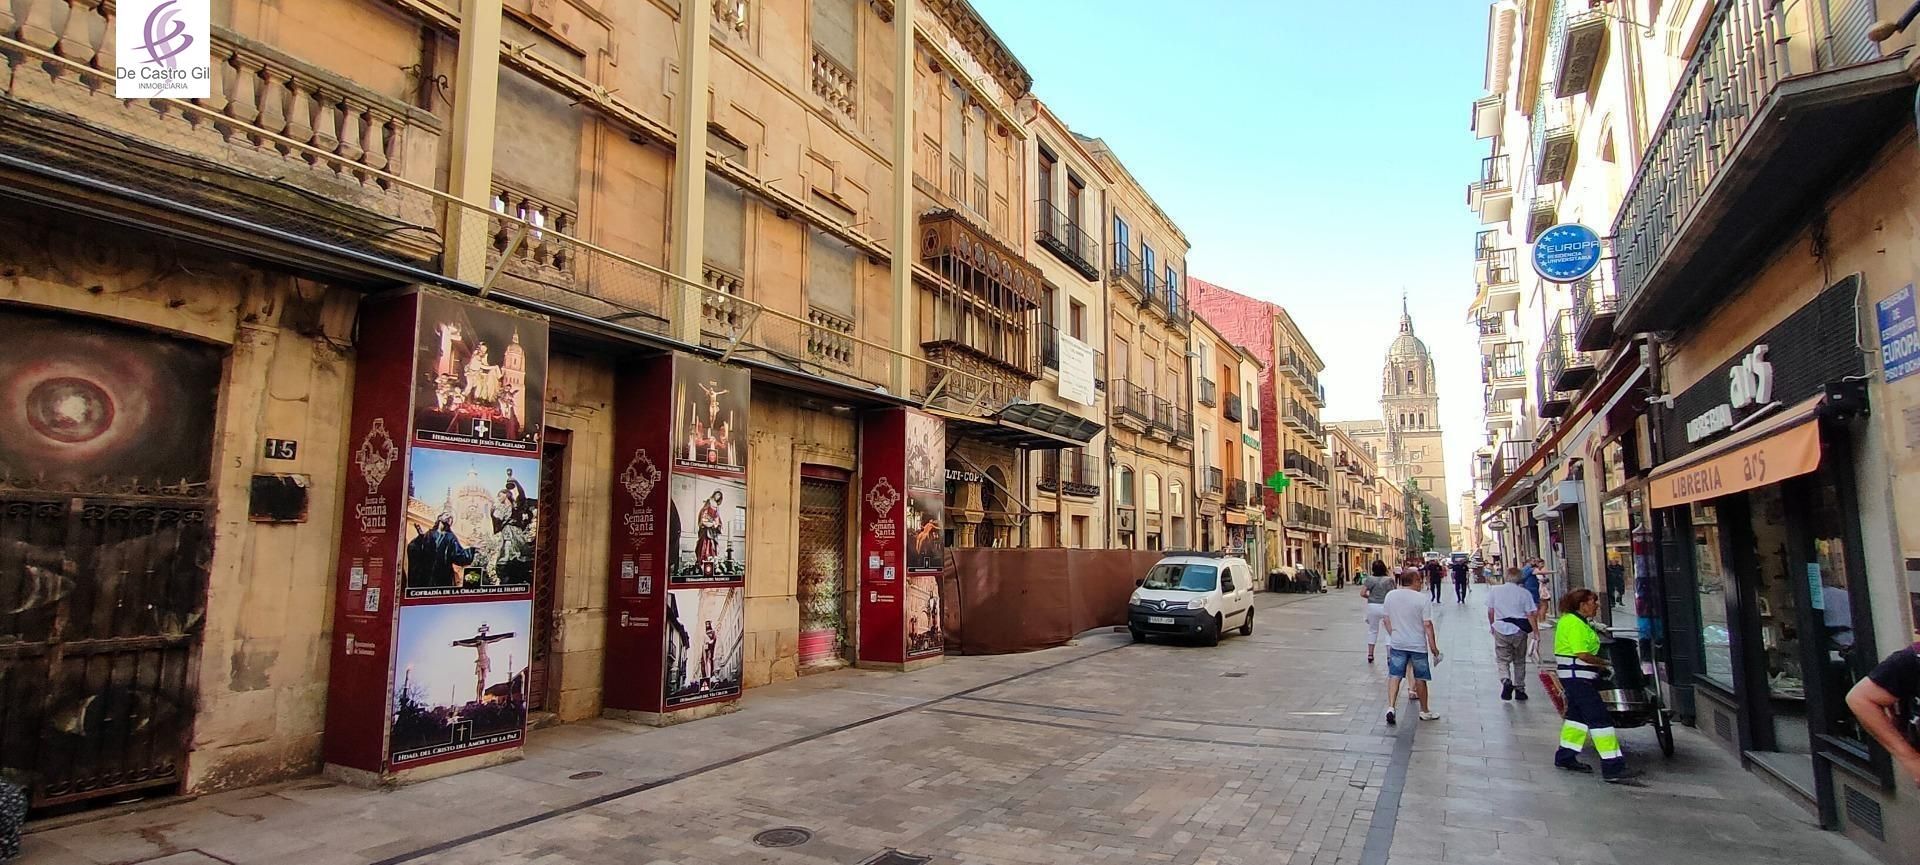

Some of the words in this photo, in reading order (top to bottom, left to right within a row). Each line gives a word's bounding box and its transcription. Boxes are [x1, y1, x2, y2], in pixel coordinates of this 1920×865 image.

[1547, 240, 1600, 253] EUROPA
[1882, 331, 1920, 364] EUROPA
[1730, 344, 1773, 409] ars
[432, 433, 471, 444] HERMANDAD
[270, 439, 294, 458] 15
[1671, 464, 1723, 499] LIBRERIA
[1744, 449, 1766, 482] ars
[355, 503, 387, 520] Semana
[361, 516, 387, 532] Santa
[624, 513, 654, 526] Semana
[629, 522, 654, 535] Santa
[869, 522, 896, 532] Semana
[874, 529, 896, 538] Santa
[410, 587, 442, 597] COFRADÍA
[432, 745, 456, 754] CRISTO
[468, 739, 485, 748] AMOR
